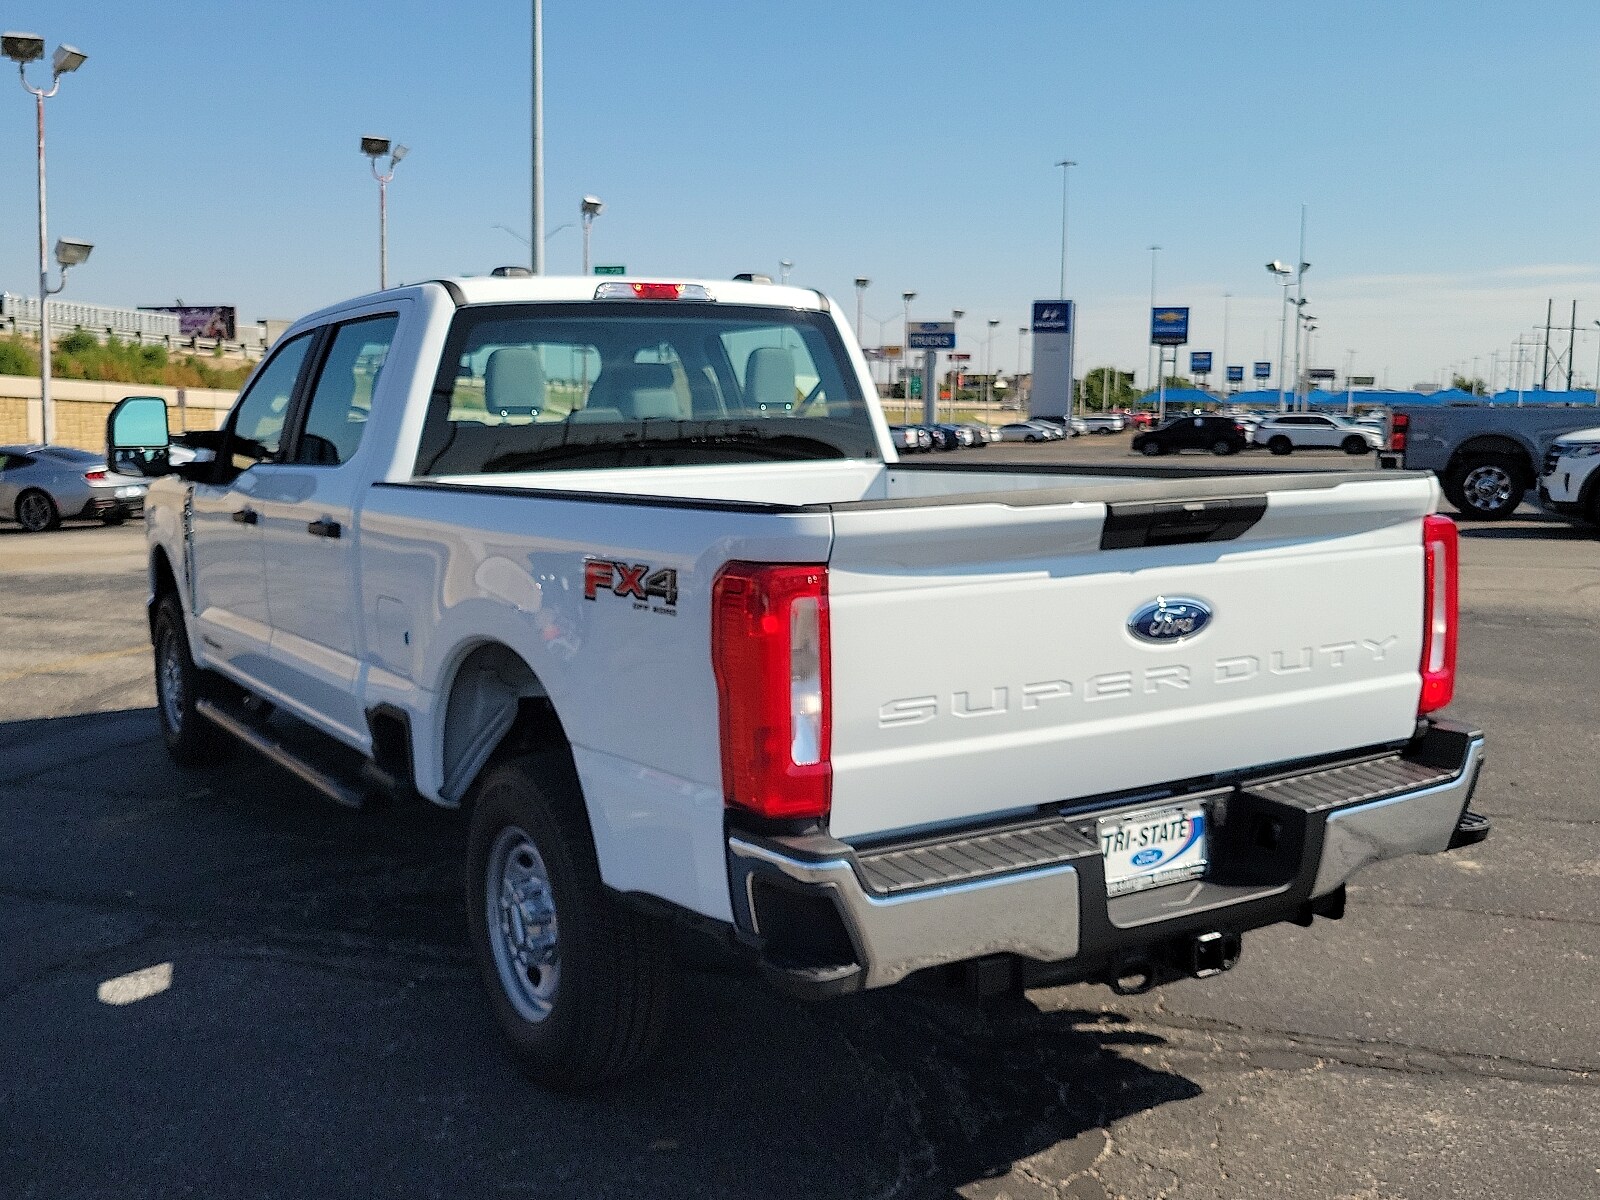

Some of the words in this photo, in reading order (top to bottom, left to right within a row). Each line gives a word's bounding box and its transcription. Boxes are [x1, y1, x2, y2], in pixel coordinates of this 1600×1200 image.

[584, 558, 678, 606] FX4
[1149, 607, 1198, 636] Ford
[879, 664, 1191, 729] SUPER
[1214, 634, 1398, 684] DUTY
[1102, 818, 1189, 855] TRI-STATE
